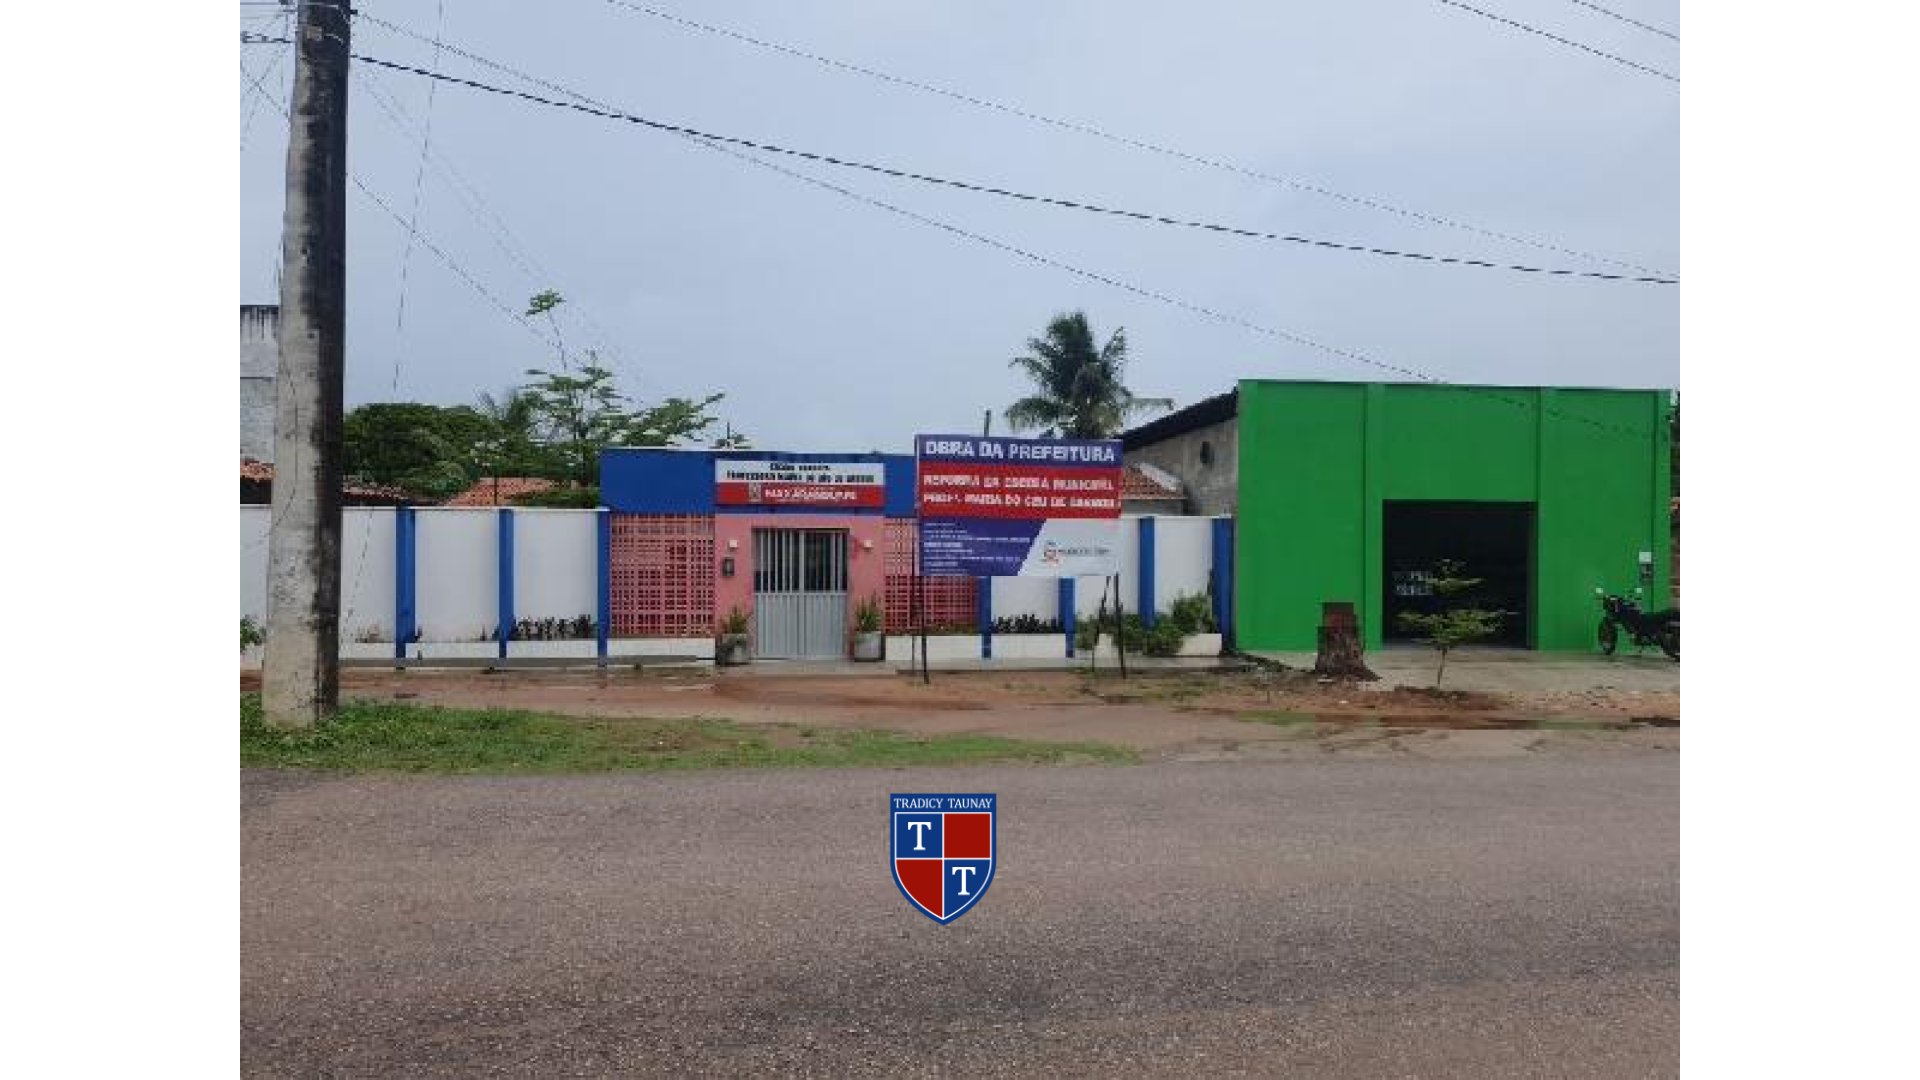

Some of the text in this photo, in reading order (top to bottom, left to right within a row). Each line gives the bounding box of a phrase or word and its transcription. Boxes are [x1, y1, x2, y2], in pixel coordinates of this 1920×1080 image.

[925, 441, 1115, 462] OBRA DA PREFEITURA
